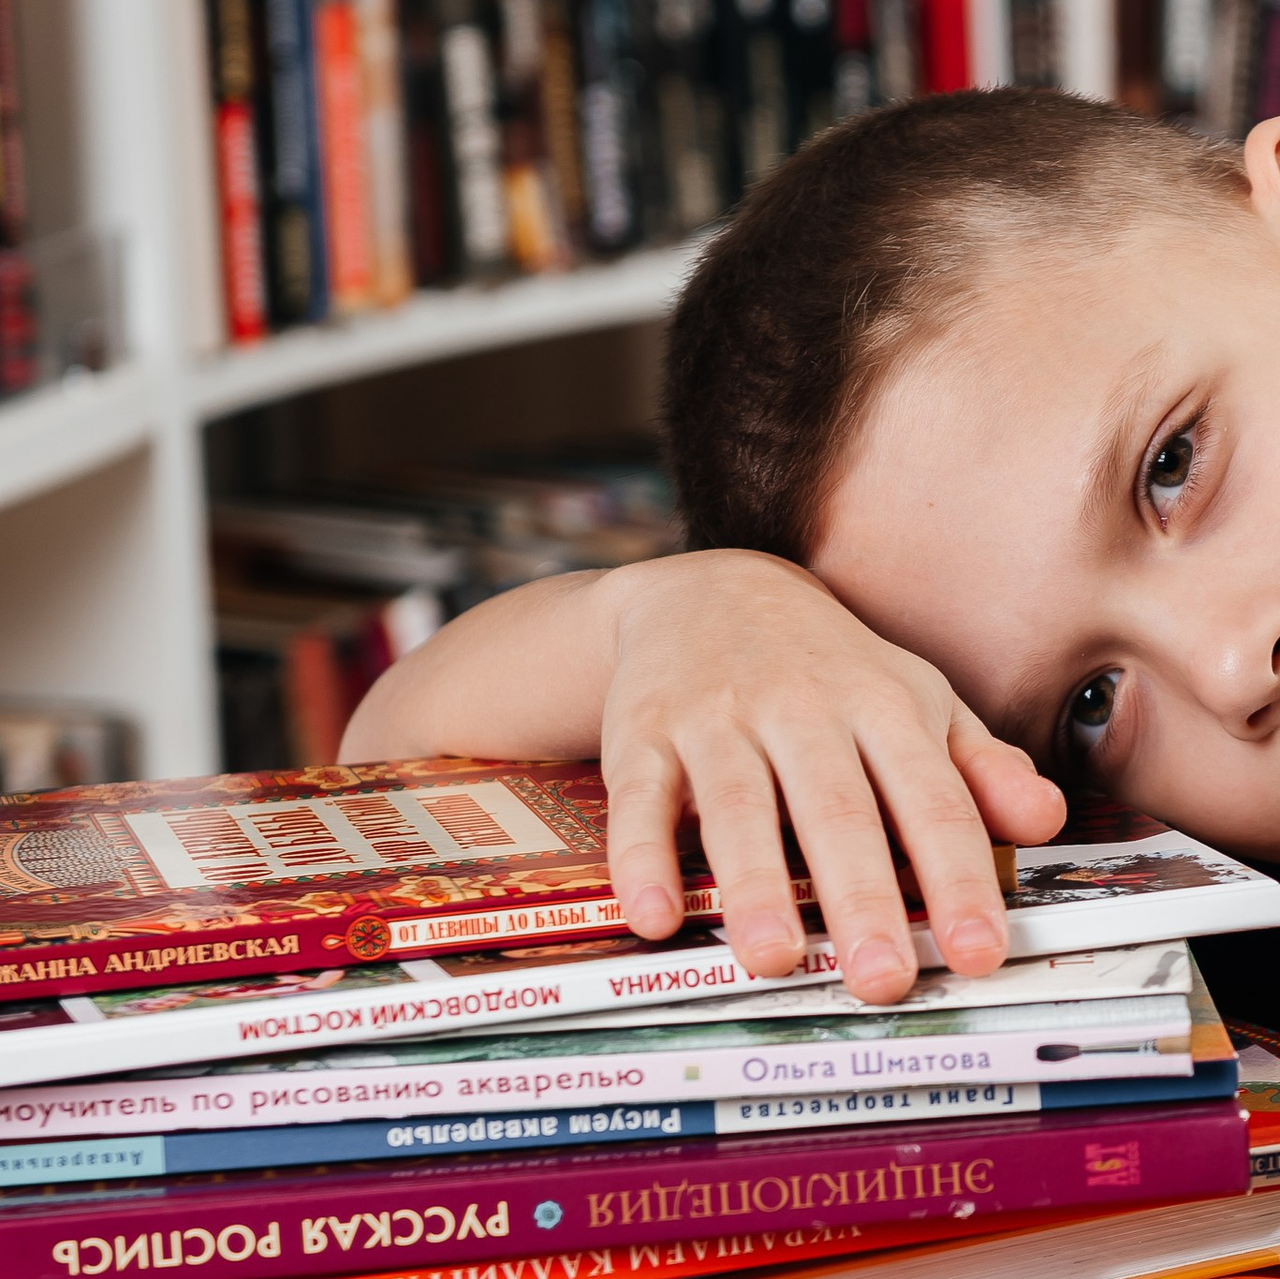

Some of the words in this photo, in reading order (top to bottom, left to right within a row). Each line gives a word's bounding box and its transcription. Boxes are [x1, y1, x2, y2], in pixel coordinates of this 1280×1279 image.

[160, 808, 270, 861] ДЕВИЦЫ
[324, 795, 420, 840] РУССКОЙ
[415, 793, 518, 850] ЖЕНЩИНЫ
[197, 861, 274, 882] ОТ
[276, 846, 363, 867] ДО
[370, 840, 441, 864] МИР
[399, 924, 419, 943] ОТ
[425, 917, 499, 941] ДЕВИЦЫ
[506, 912, 528, 933] ДО
[534, 906, 591, 929] БАБЫ.
[596, 901, 624, 921] МИ
[0, 956, 99, 984] ЖАННА
[104, 934, 300, 973] АНДРИЕВСКАЯ
[608, 964, 736, 997] ПРОКИНА
[238, 1007, 363, 1042] КОСТЮМ
[371, 984, 561, 1031] МОРДОВСКИЙ
[192, 1091, 234, 1111] по
[249, 1076, 443, 1116] рисованию
[456, 1065, 645, 1099] акварелью
[742, 1057, 836, 1082] Ольга
[851, 1050, 992, 1076] Шматова
[928, 1083, 1015, 1106] Грани
[569, 1107, 683, 1135] Рисуем
[739, 1091, 912, 1120] творчества
[386, 1115, 558, 1148] акварелью
[585, 1158, 996, 1229] ЭНЦИКЛОПЕДИЯ
[52, 1221, 282, 1276] РОСПИСЬ
[302, 1200, 511, 1255] РУССКАЯ
